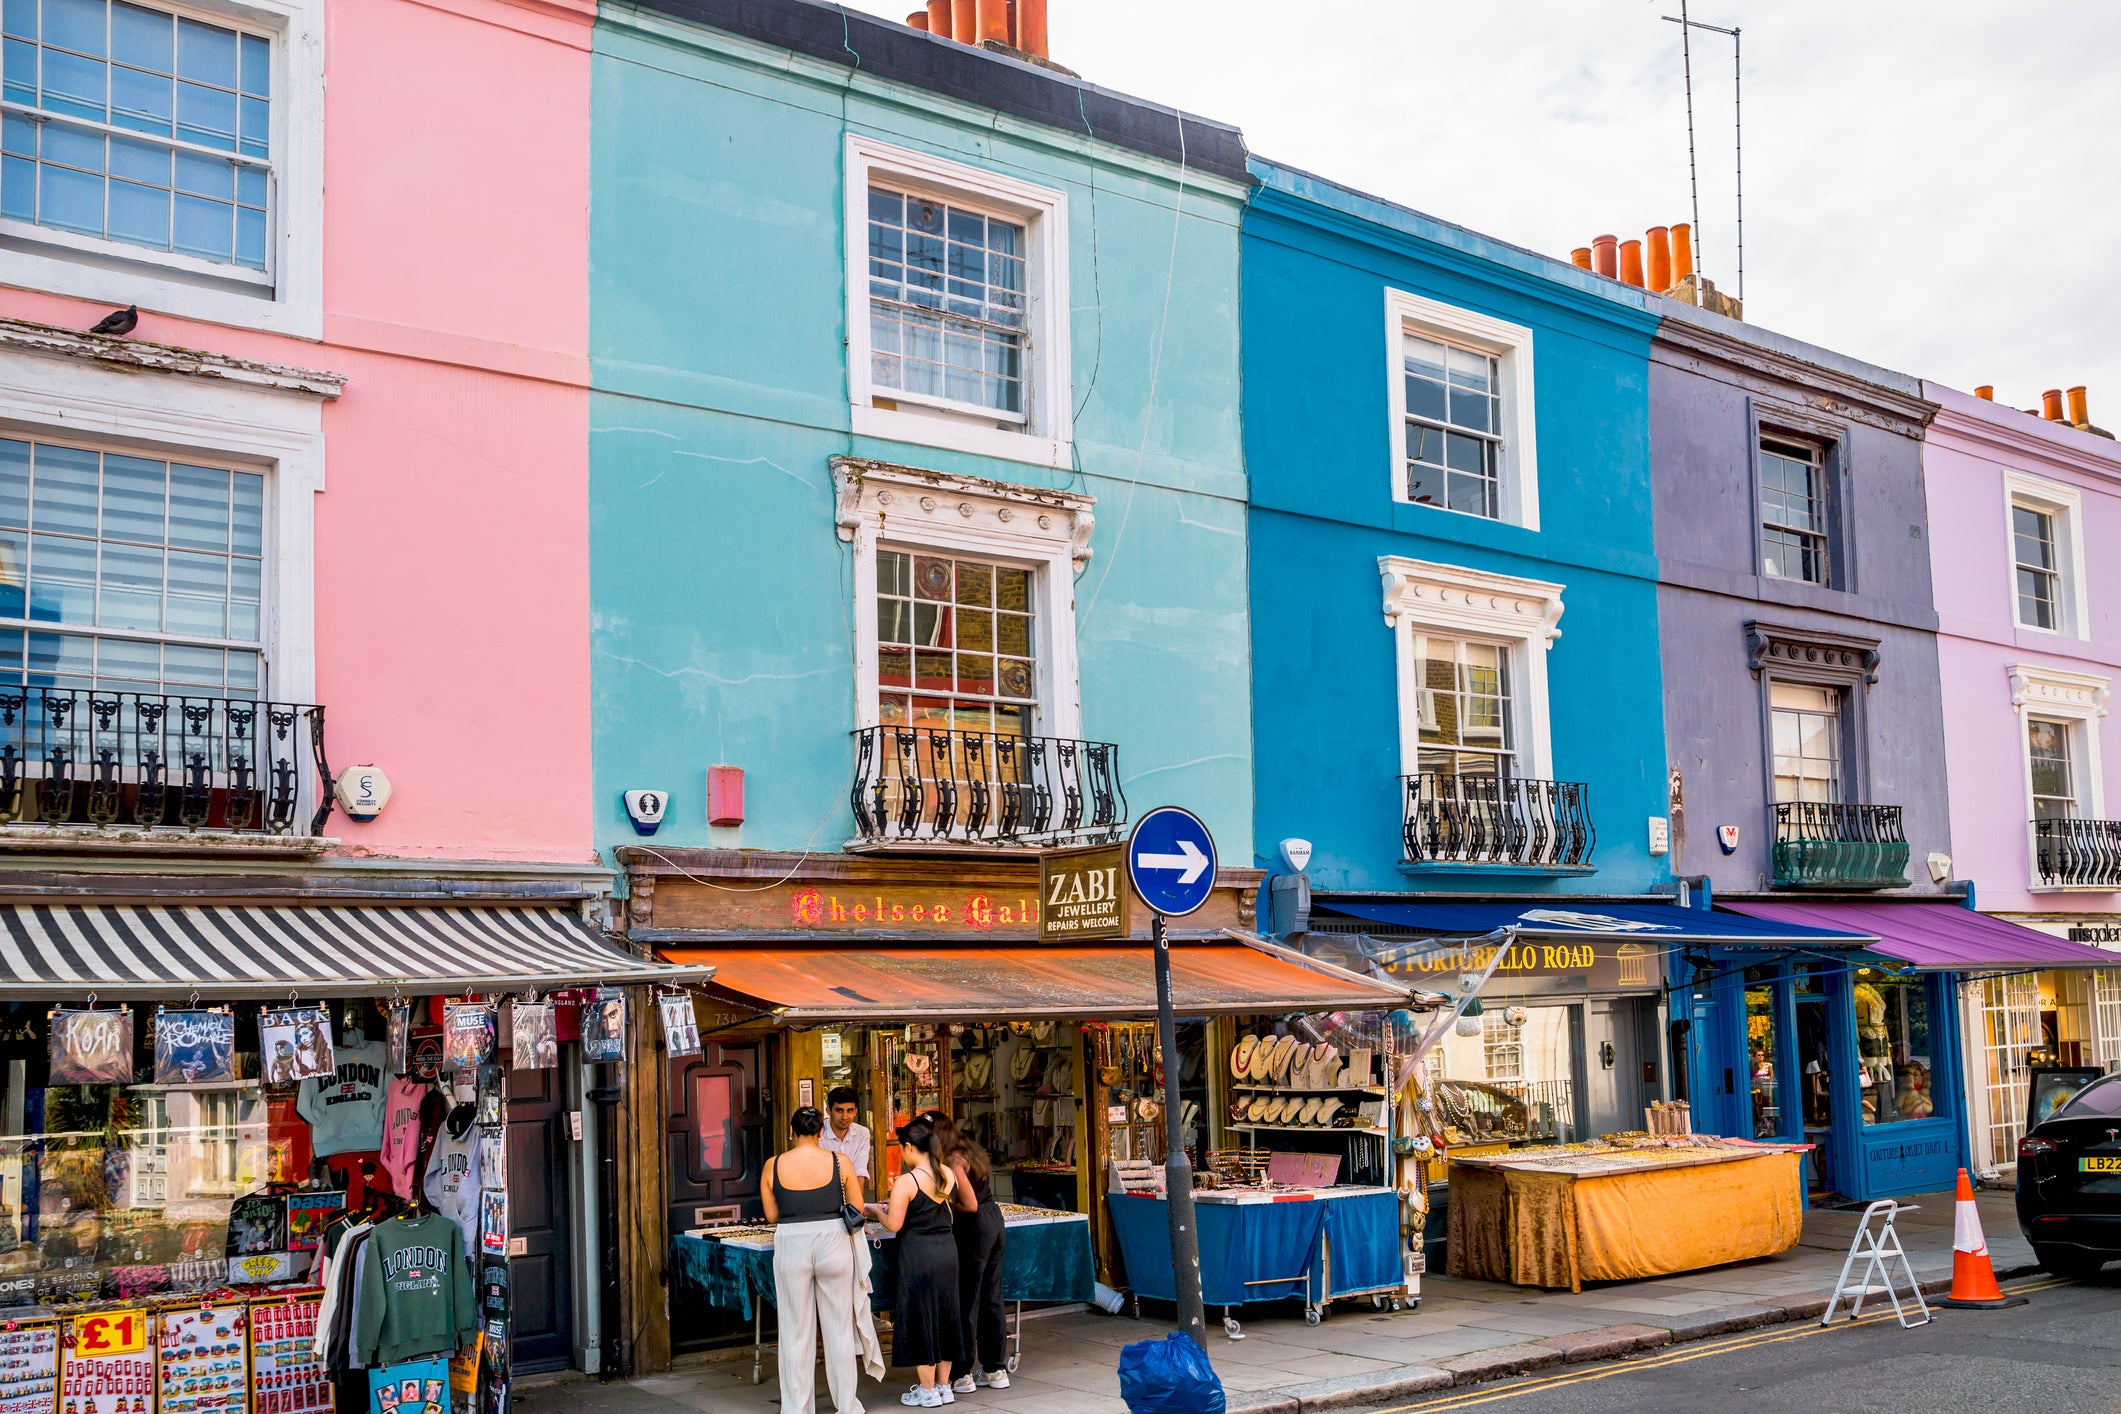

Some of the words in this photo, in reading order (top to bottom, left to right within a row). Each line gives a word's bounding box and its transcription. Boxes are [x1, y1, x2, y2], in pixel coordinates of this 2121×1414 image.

[1048, 867, 1117, 906] ZABI
[794, 889, 949, 925] Chelsea
[1057, 901, 1117, 918] JEWELLERY
[1047, 920, 1079, 932] REPAIRS
[1082, 916, 1120, 929] WELCOME
[1543, 945, 1595, 969] ROAD
[263, 1009, 330, 1027] BACK
[457, 1015, 485, 1027] MUSE
[318, 1063, 381, 1093] LONDON
[326, 1092, 372, 1106] ENGLAND
[481, 1127, 502, 1139] SPICE
[2087, 1158, 2121, 1170] LB22
[289, 1194, 343, 1209] oasis
[241, 1255, 279, 1269] GREEN
[383, 1245, 448, 1281] LONDON
[52, 1270, 100, 1284] SECONDS
[246, 1267, 271, 1278] DAY
[83, 1316, 132, 1350] £1
